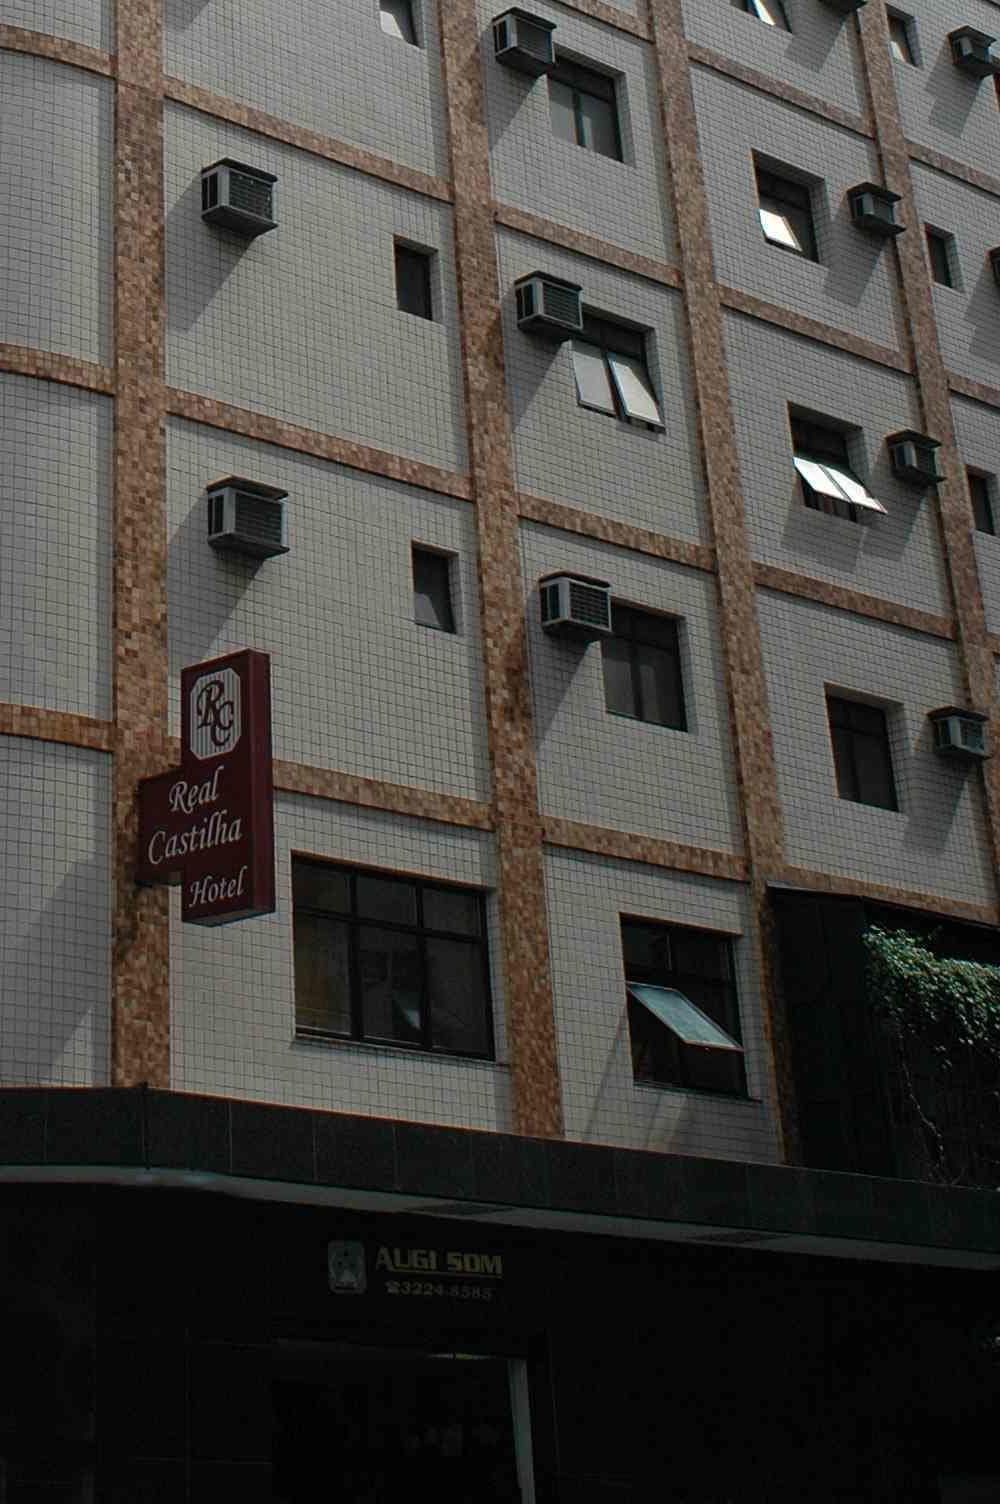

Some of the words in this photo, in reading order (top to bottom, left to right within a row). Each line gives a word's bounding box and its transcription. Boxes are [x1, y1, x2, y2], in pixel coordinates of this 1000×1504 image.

[168, 765, 224, 814] Real
[148, 809, 243, 865] Castilha
[188, 865, 248, 908] Hotel
